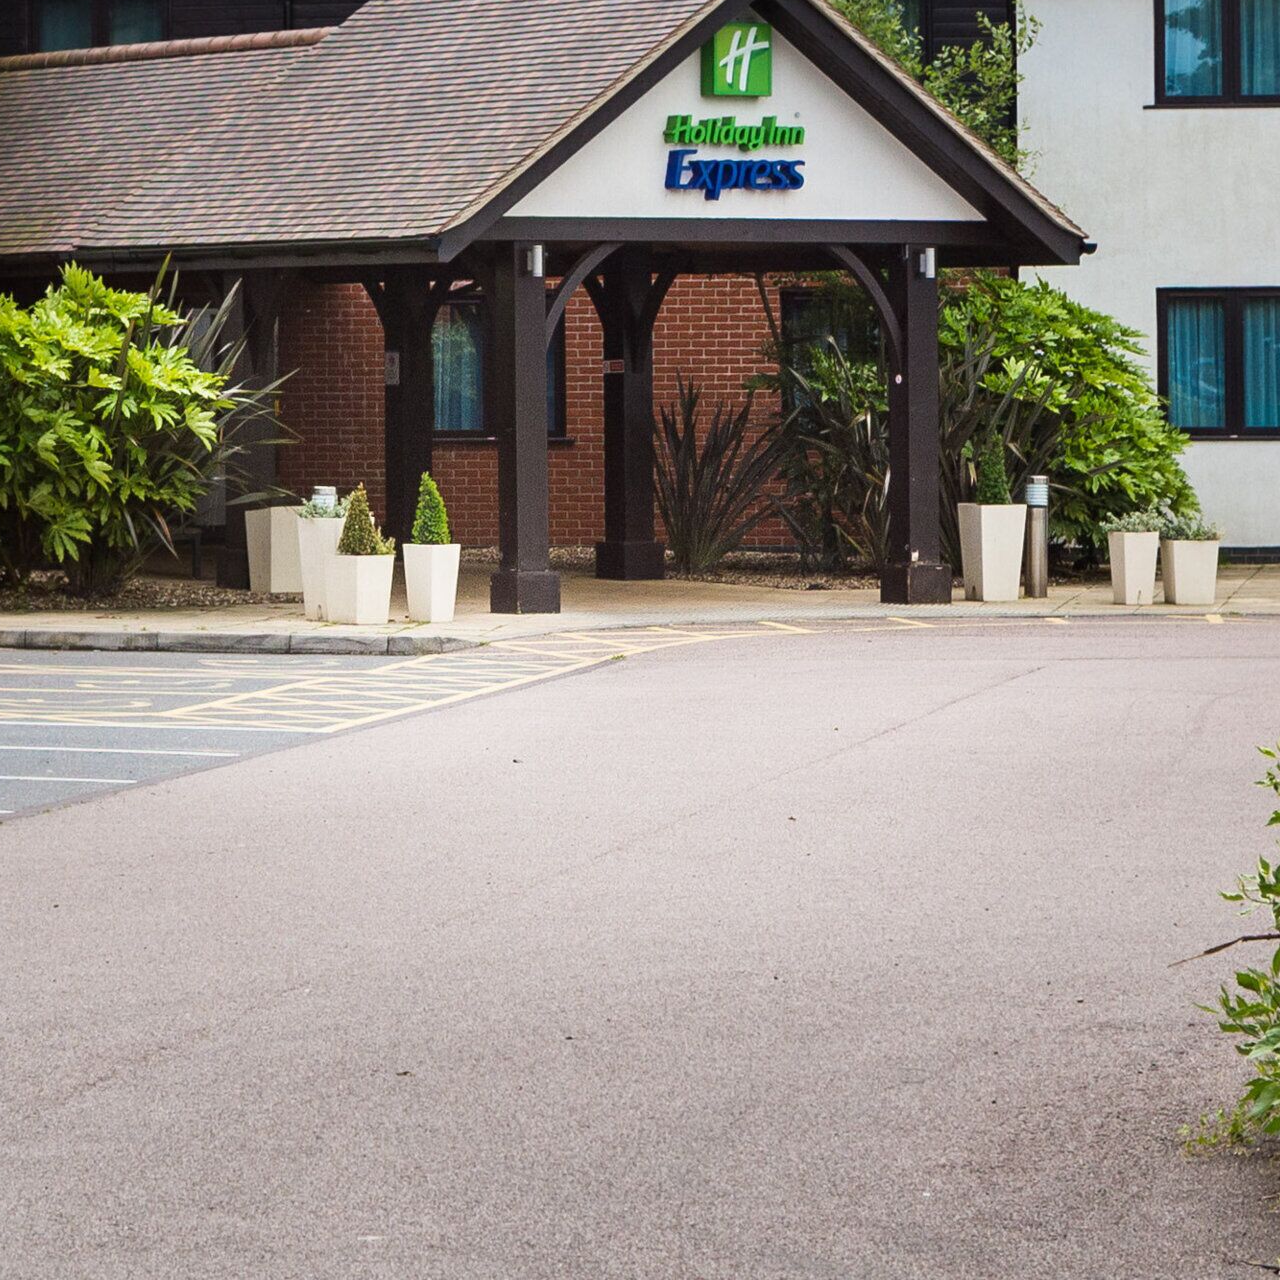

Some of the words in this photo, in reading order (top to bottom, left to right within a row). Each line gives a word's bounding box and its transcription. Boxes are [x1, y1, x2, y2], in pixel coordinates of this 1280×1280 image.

[719, 26, 770, 92] H
[663, 115, 765, 151] Holiday
[766, 116, 805, 145] Inn
[665, 149, 806, 200] Express
